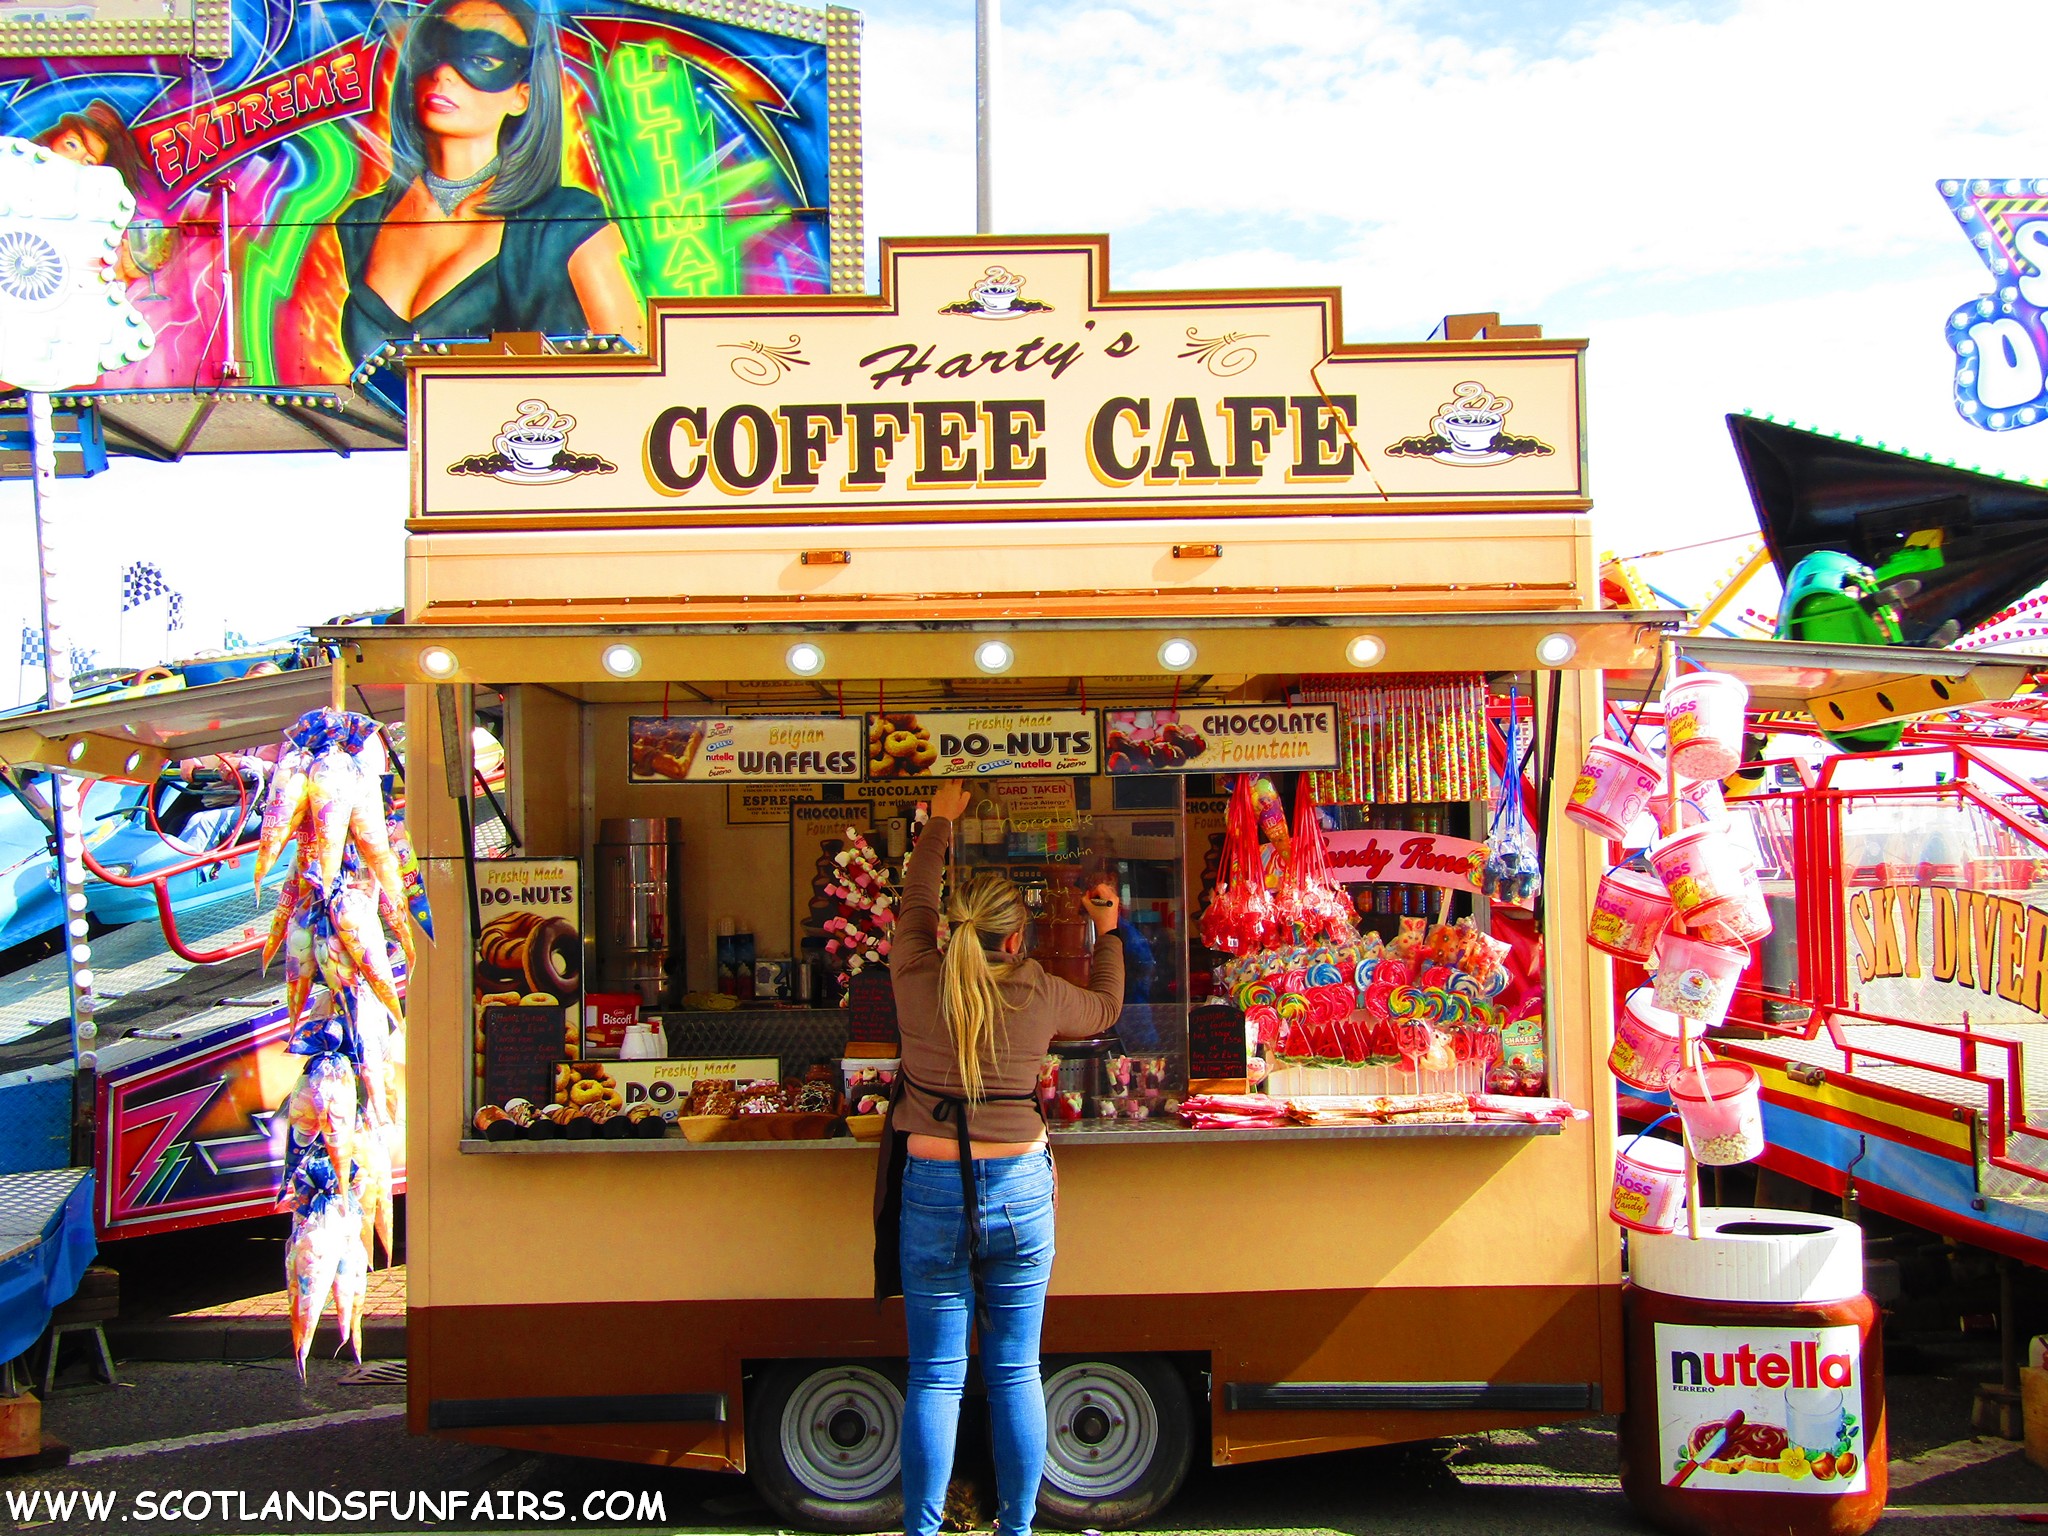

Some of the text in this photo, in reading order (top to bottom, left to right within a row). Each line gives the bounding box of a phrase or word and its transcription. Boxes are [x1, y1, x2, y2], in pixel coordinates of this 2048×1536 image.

[150, 52, 363, 190] EXTREME
[859, 320, 1140, 390] Harty's
[642, 394, 1359, 495] COFFEE CAFE
[968, 714, 1052, 731] Freshly Made
[1202, 711, 1330, 736] CHOCOLATE
[769, 726, 825, 750] Belgian
[940, 731, 1092, 757] DO-NUTS
[706, 752, 735, 761] nutella
[1219, 739, 1312, 764] Fountain
[738, 751, 857, 774] WAFFLES
[977, 758, 1013, 772] OREO
[1014, 758, 1052, 769] nutella
[1056, 760, 1087, 770] bueno
[858, 785, 938, 796] CHOCOLATE
[998, 785, 1066, 795] CARD TAKEN
[797, 807, 867, 821] CHOCOLATE
[1400, 837, 1473, 875] Time
[487, 866, 564, 884] Freshly Made
[480, 885, 574, 906] DO-NUTS
[1850, 884, 1922, 985] SKY
[603, 1013, 632, 1024] Biscoff
[654, 1061, 737, 1079] Freshly Made
[1616, 1173, 1652, 1196] FLOSS
[1671, 1340, 1852, 1389] nutella
[1672, 1384, 1715, 1394] FERRERO
